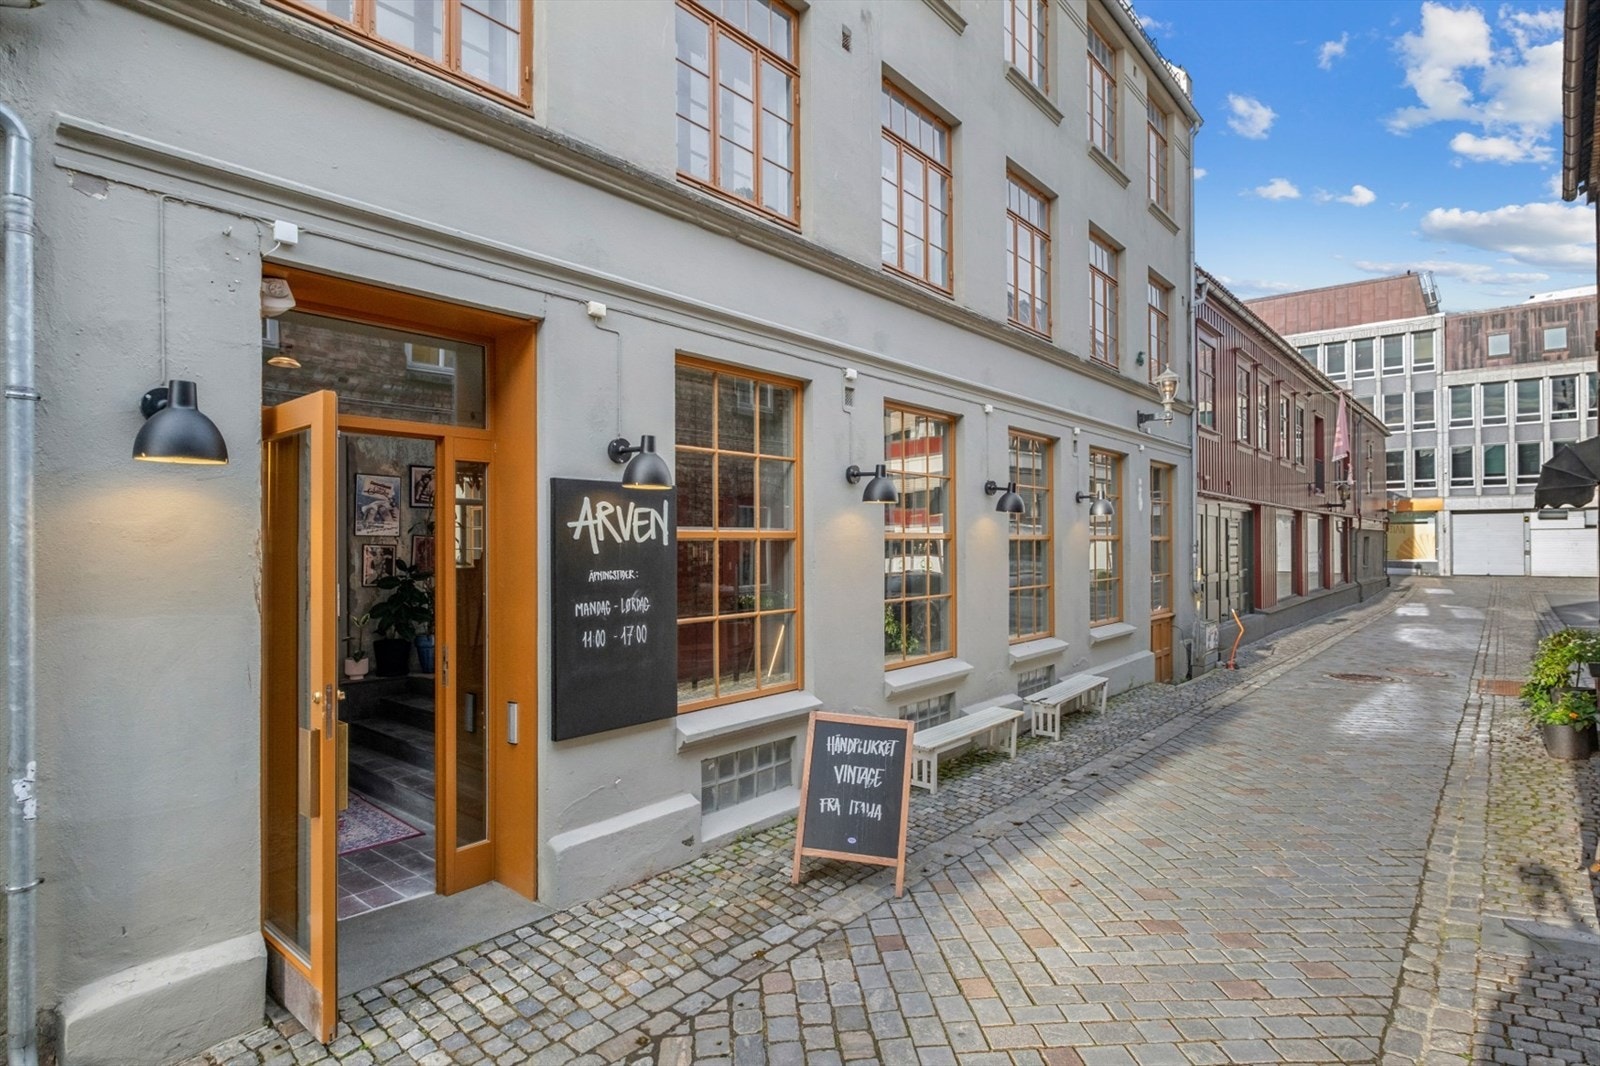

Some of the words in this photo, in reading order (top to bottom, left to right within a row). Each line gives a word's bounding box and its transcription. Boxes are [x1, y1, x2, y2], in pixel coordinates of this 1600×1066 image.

[567, 496, 669, 555] ARVEN
[575, 600, 611, 617] MANDAG
[620, 596, 651, 614] LØRDAG
[827, 734, 899, 757] HÅNDPLUKKET
[834, 765, 885, 789] VINTAGE
[819, 797, 841, 816] FRA
